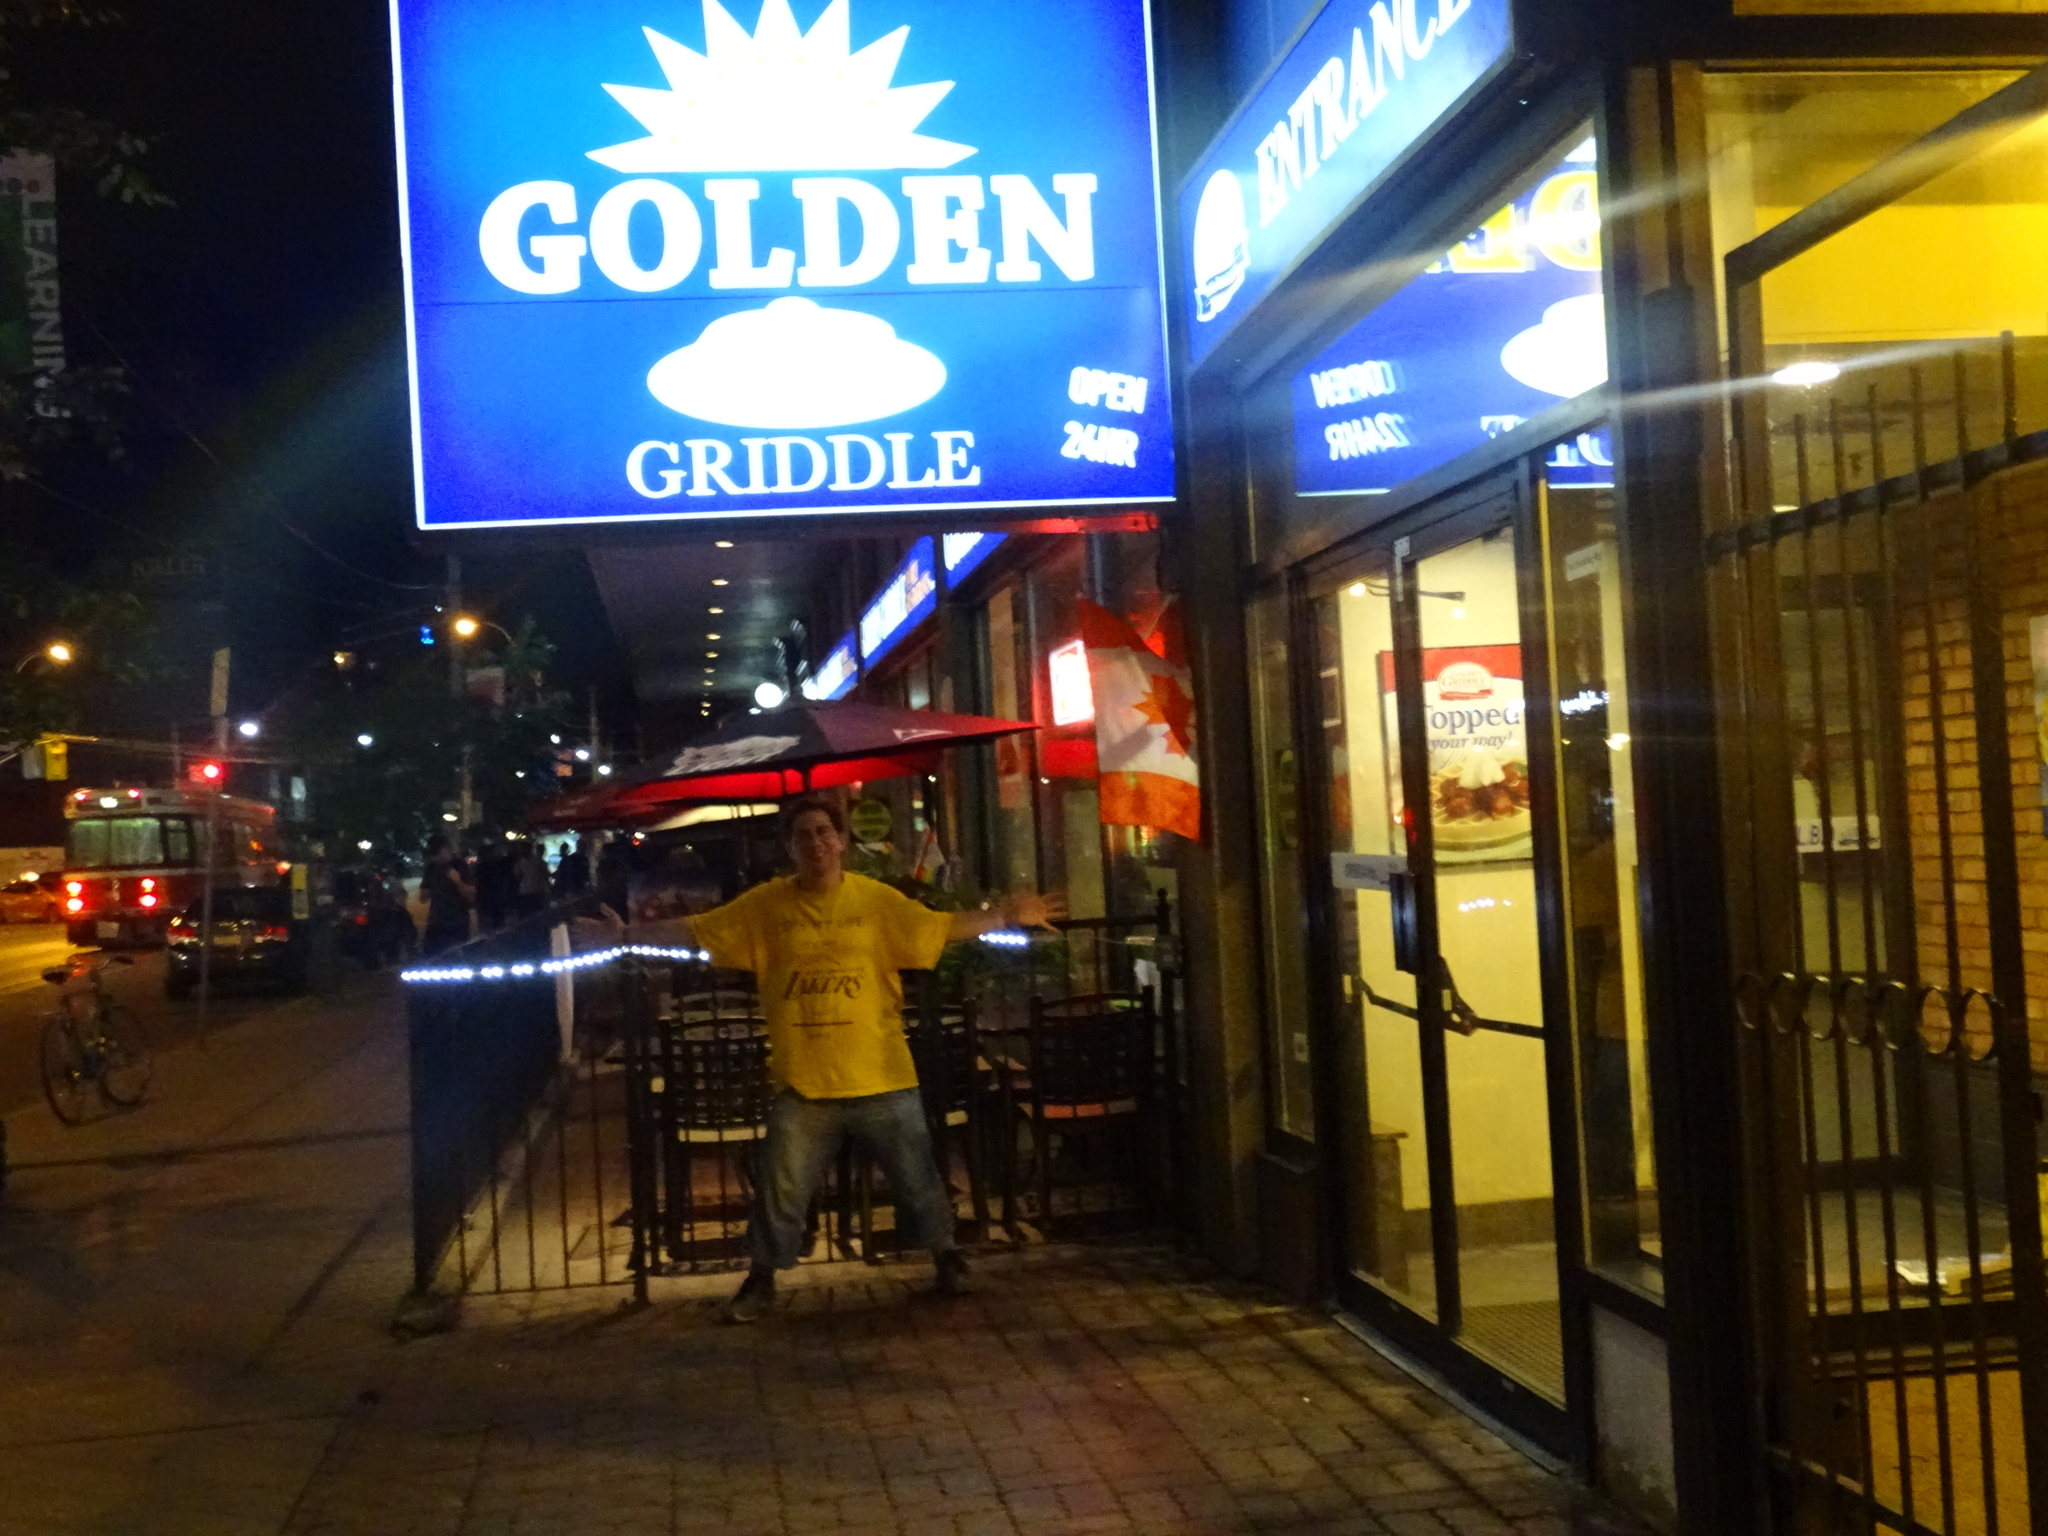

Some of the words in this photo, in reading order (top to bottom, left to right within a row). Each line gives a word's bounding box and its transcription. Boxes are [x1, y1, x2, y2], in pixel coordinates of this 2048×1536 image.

[478, 172, 1098, 295] GOLDEN
[1067, 365, 1149, 415] OPEN
[625, 429, 982, 499] GRIDDLE
